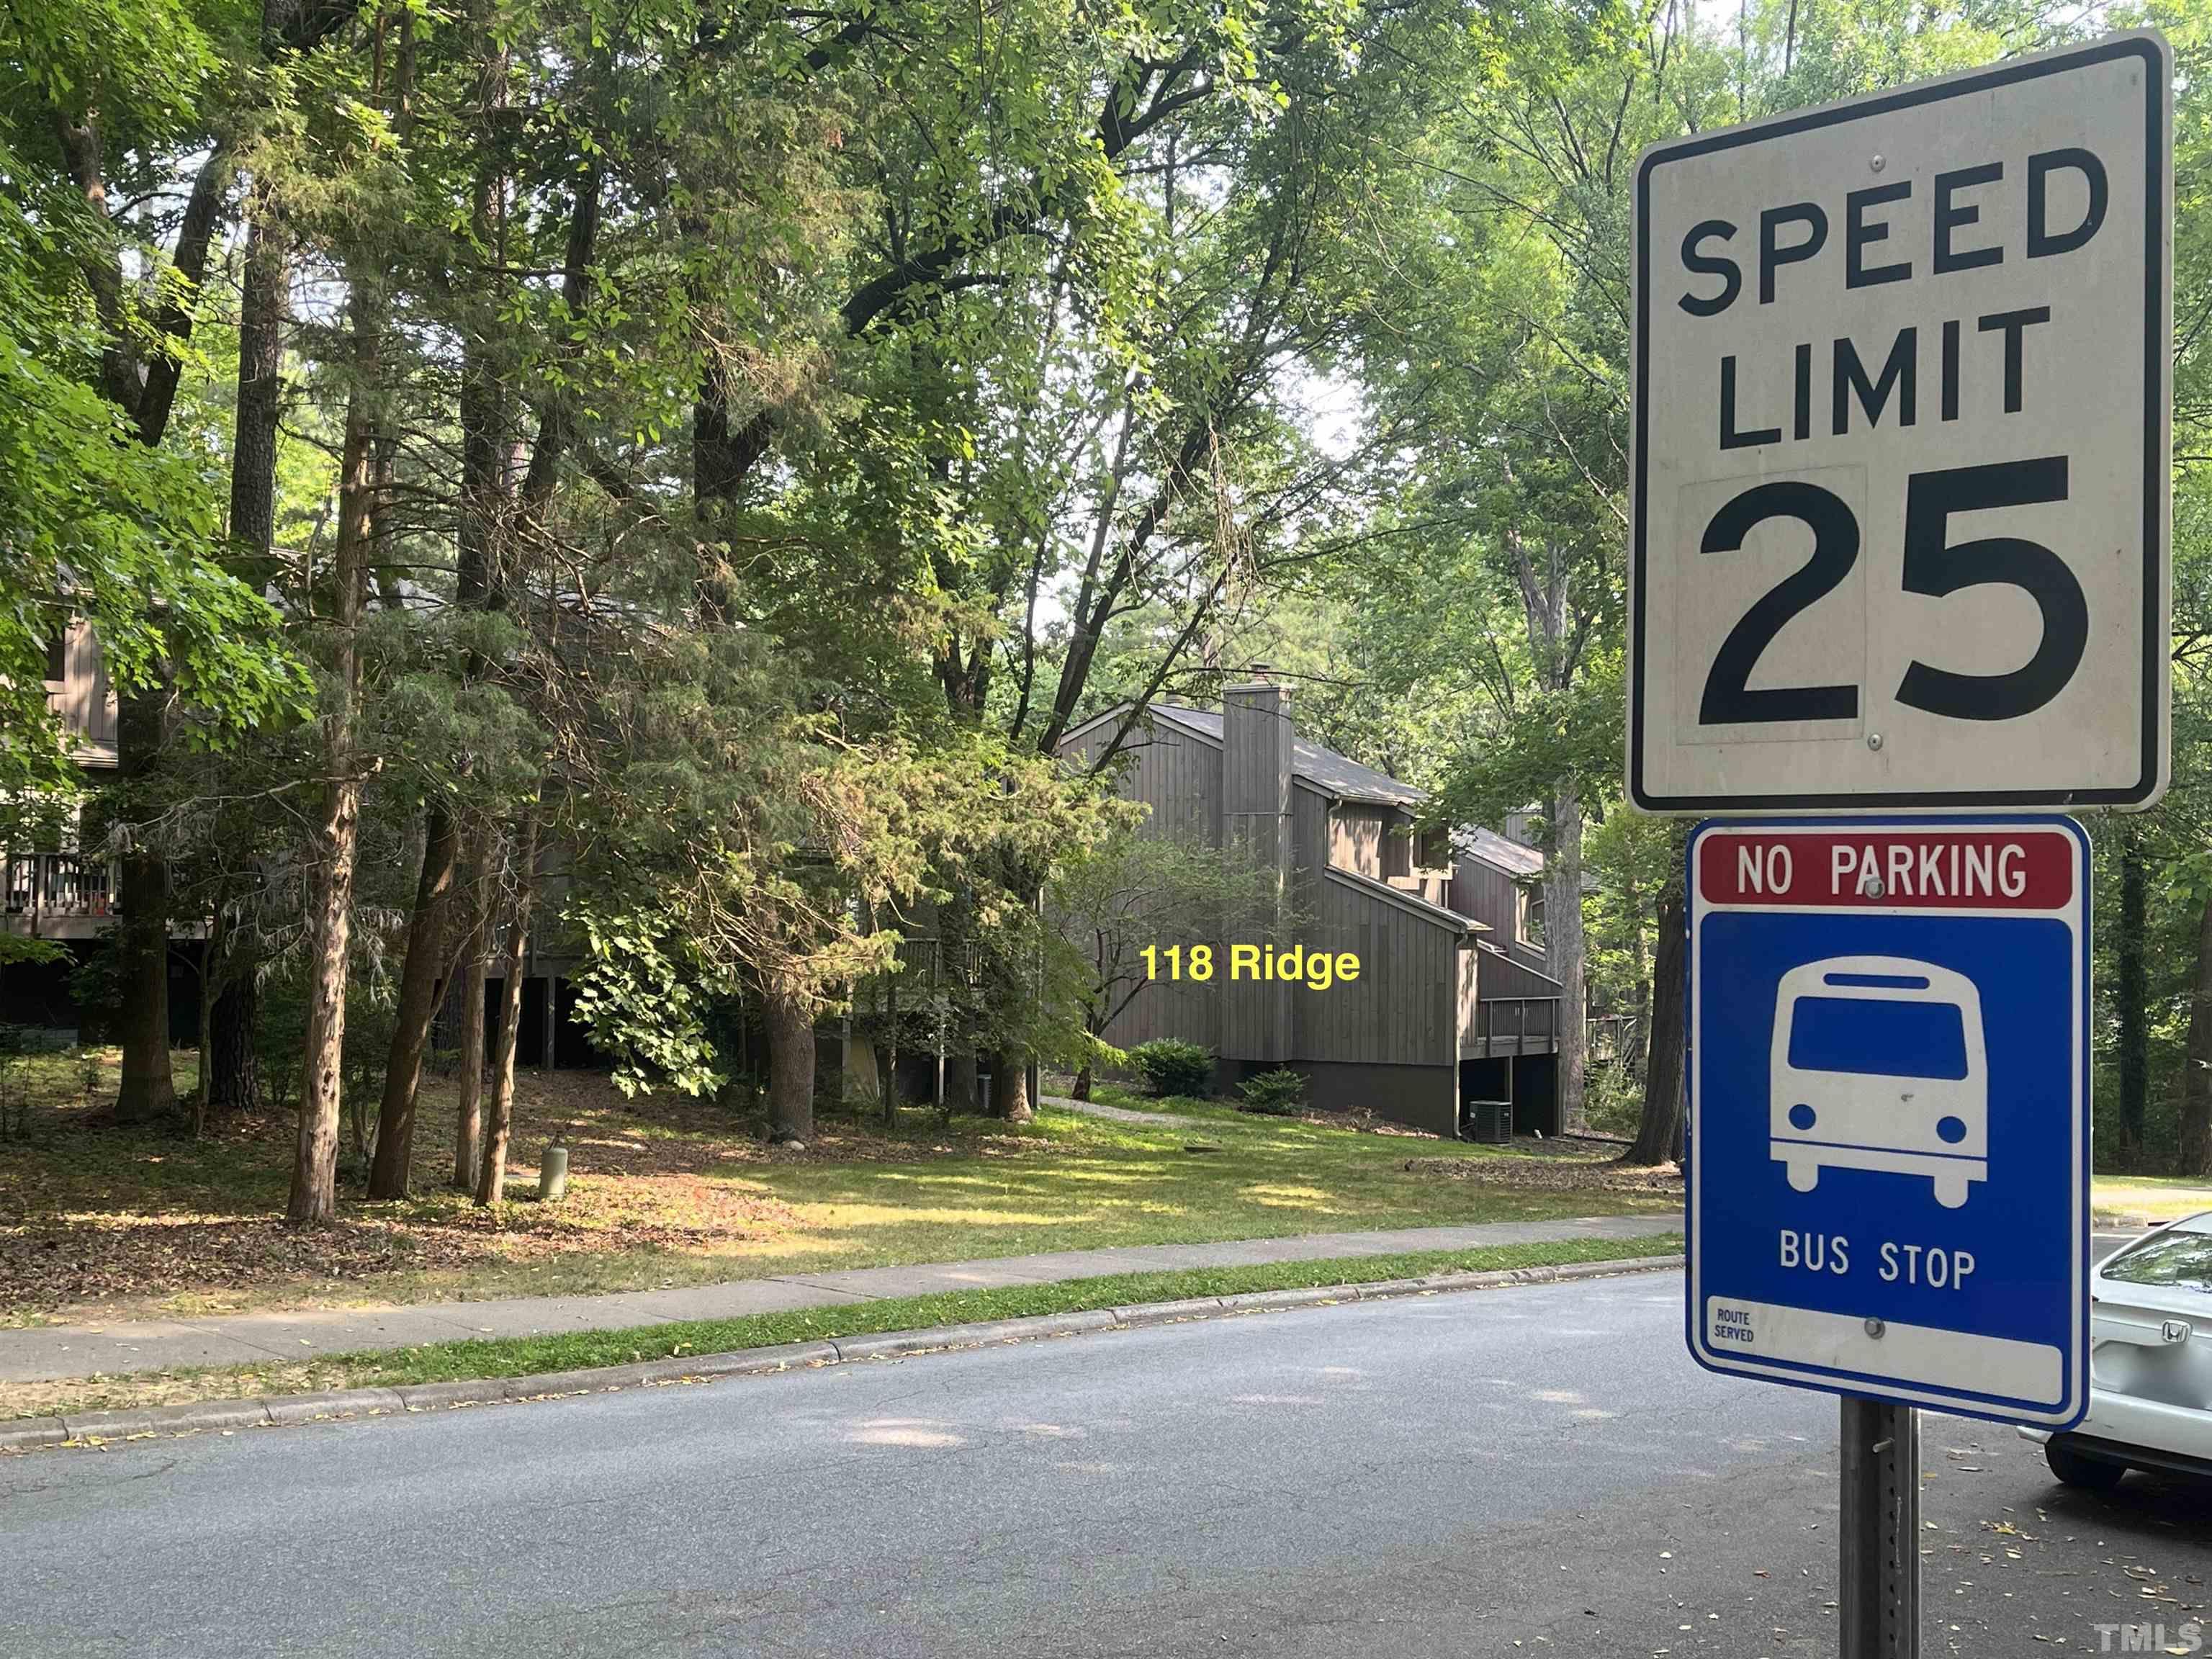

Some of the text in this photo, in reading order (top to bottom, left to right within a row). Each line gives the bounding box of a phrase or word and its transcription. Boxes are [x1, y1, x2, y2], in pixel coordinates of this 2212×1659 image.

[1678, 147, 2108, 317] SPEED
[1719, 306, 2050, 450] LIMIT
[1699, 455, 2089, 725] 25
[1737, 844, 2027, 898] NO PARKING
[1779, 1230, 1975, 1290] BUS STOP
[1714, 1324, 1754, 1342] SERVED
[1717, 1308, 1750, 1326] ROUTE
